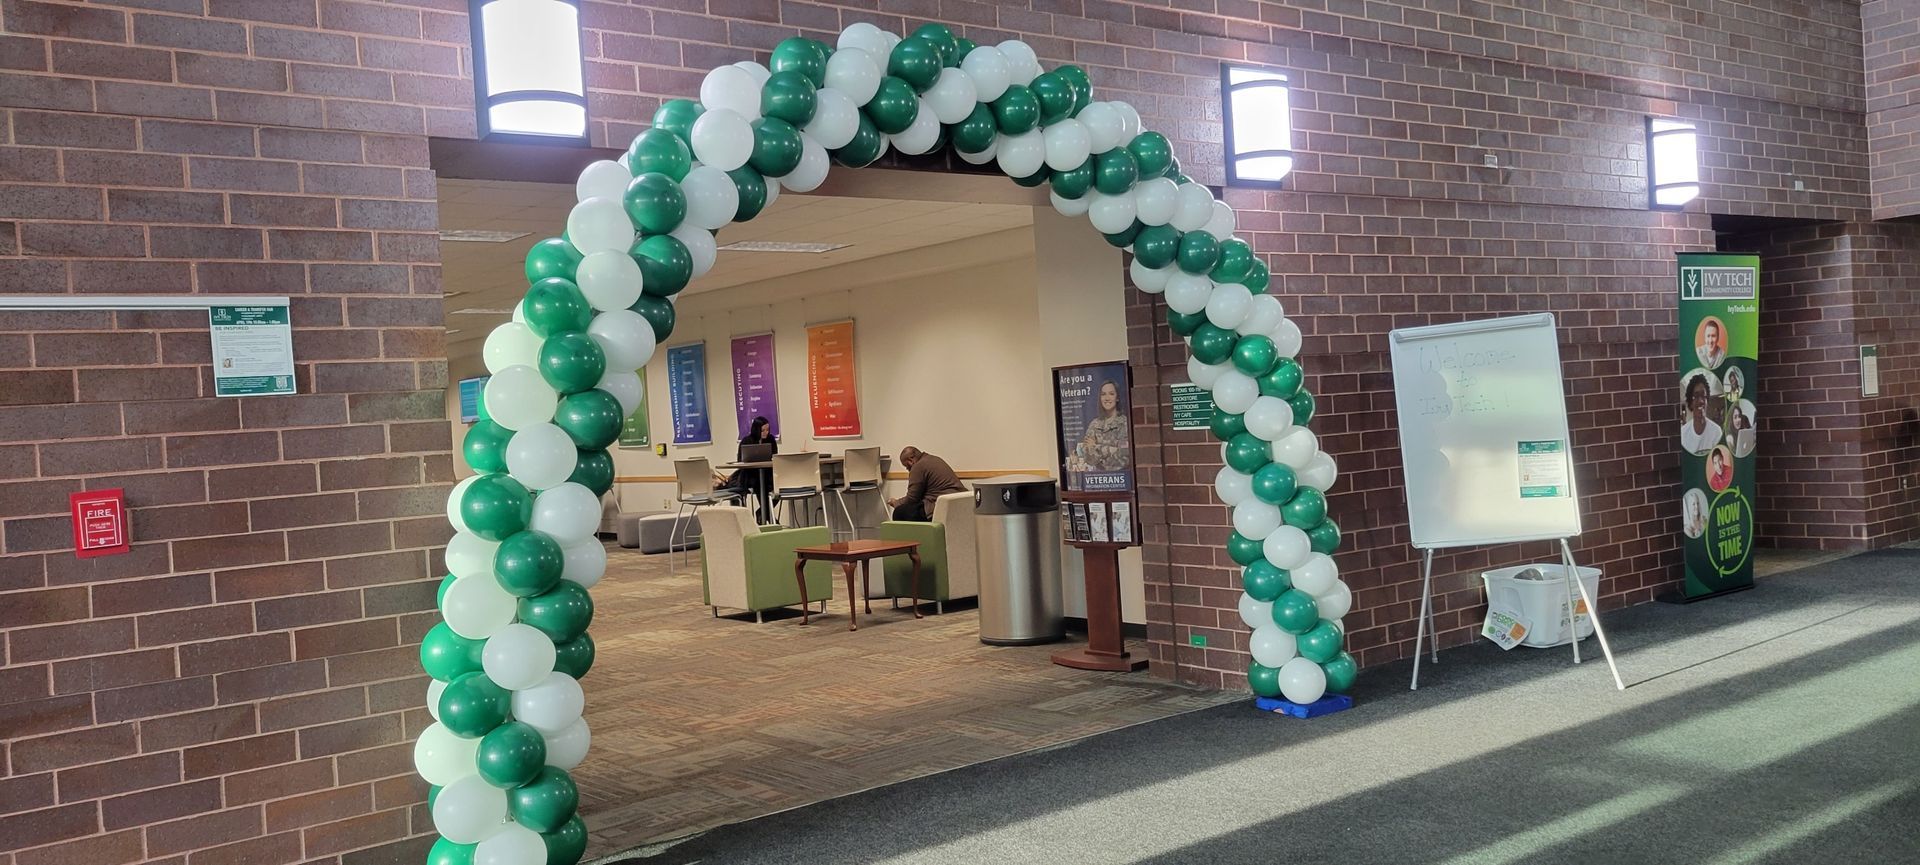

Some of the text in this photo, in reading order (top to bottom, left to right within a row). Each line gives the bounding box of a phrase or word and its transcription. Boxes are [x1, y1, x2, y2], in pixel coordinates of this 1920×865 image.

[1704, 272, 1752, 287] IVY TECH
[1727, 304, 1756, 314] IvyTech.edu
[1419, 342, 1515, 375] Welcome
[1060, 374, 1093, 385] Are you a
[1456, 370, 1478, 388] to
[736, 368, 744, 411] EXECUTING
[1060, 386, 1091, 397] Veteran?
[1085, 475, 1125, 484] VETERANS
[87, 508, 112, 518] FIRE
[1716, 501, 1740, 527] NOW
[1719, 524, 1741, 538] IS THE
[1718, 536, 1742, 561] TIME
